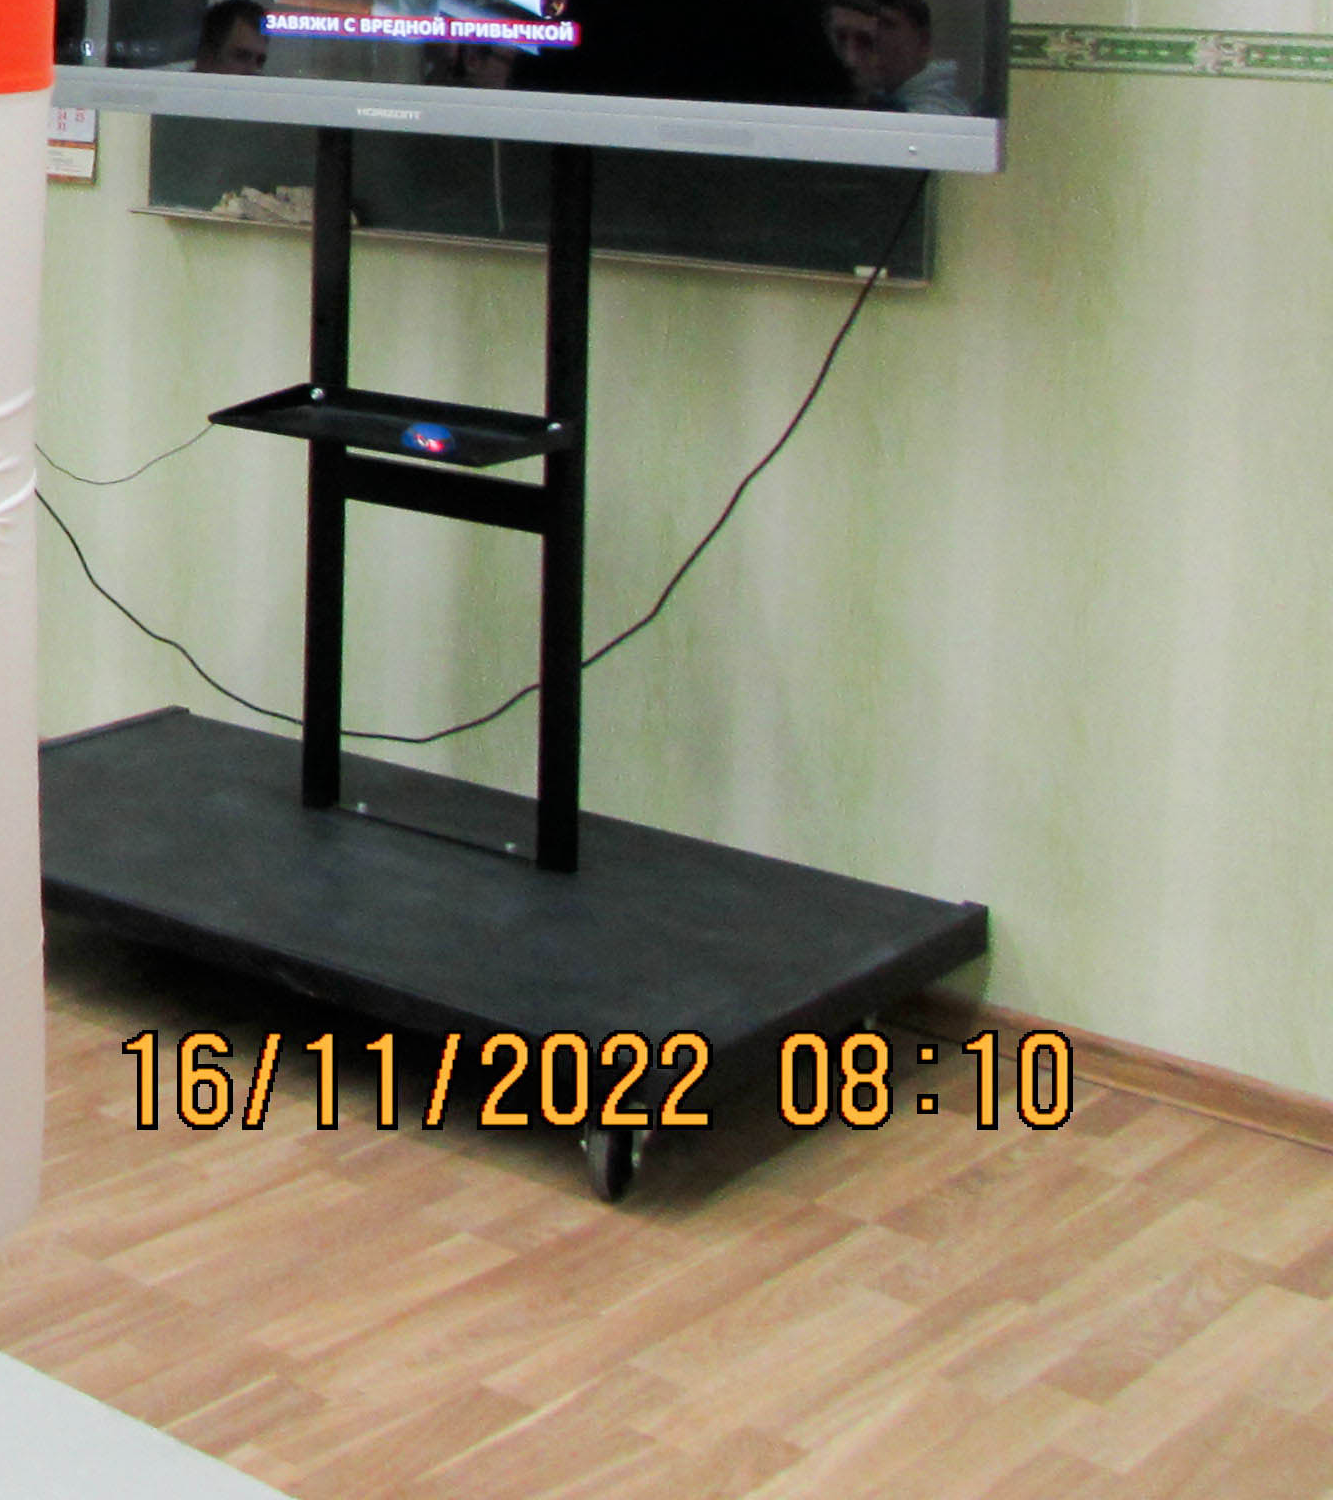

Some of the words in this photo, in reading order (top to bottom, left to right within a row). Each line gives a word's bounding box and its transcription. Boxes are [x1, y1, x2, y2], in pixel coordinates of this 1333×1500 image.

[265, 14, 340, 32] ЗАВЯЖИ
[344, 17, 355, 32] С
[360, 16, 445, 37] ВРЕДНОЙ
[450, 20, 574, 42] ПРИВЫЧКОЙ
